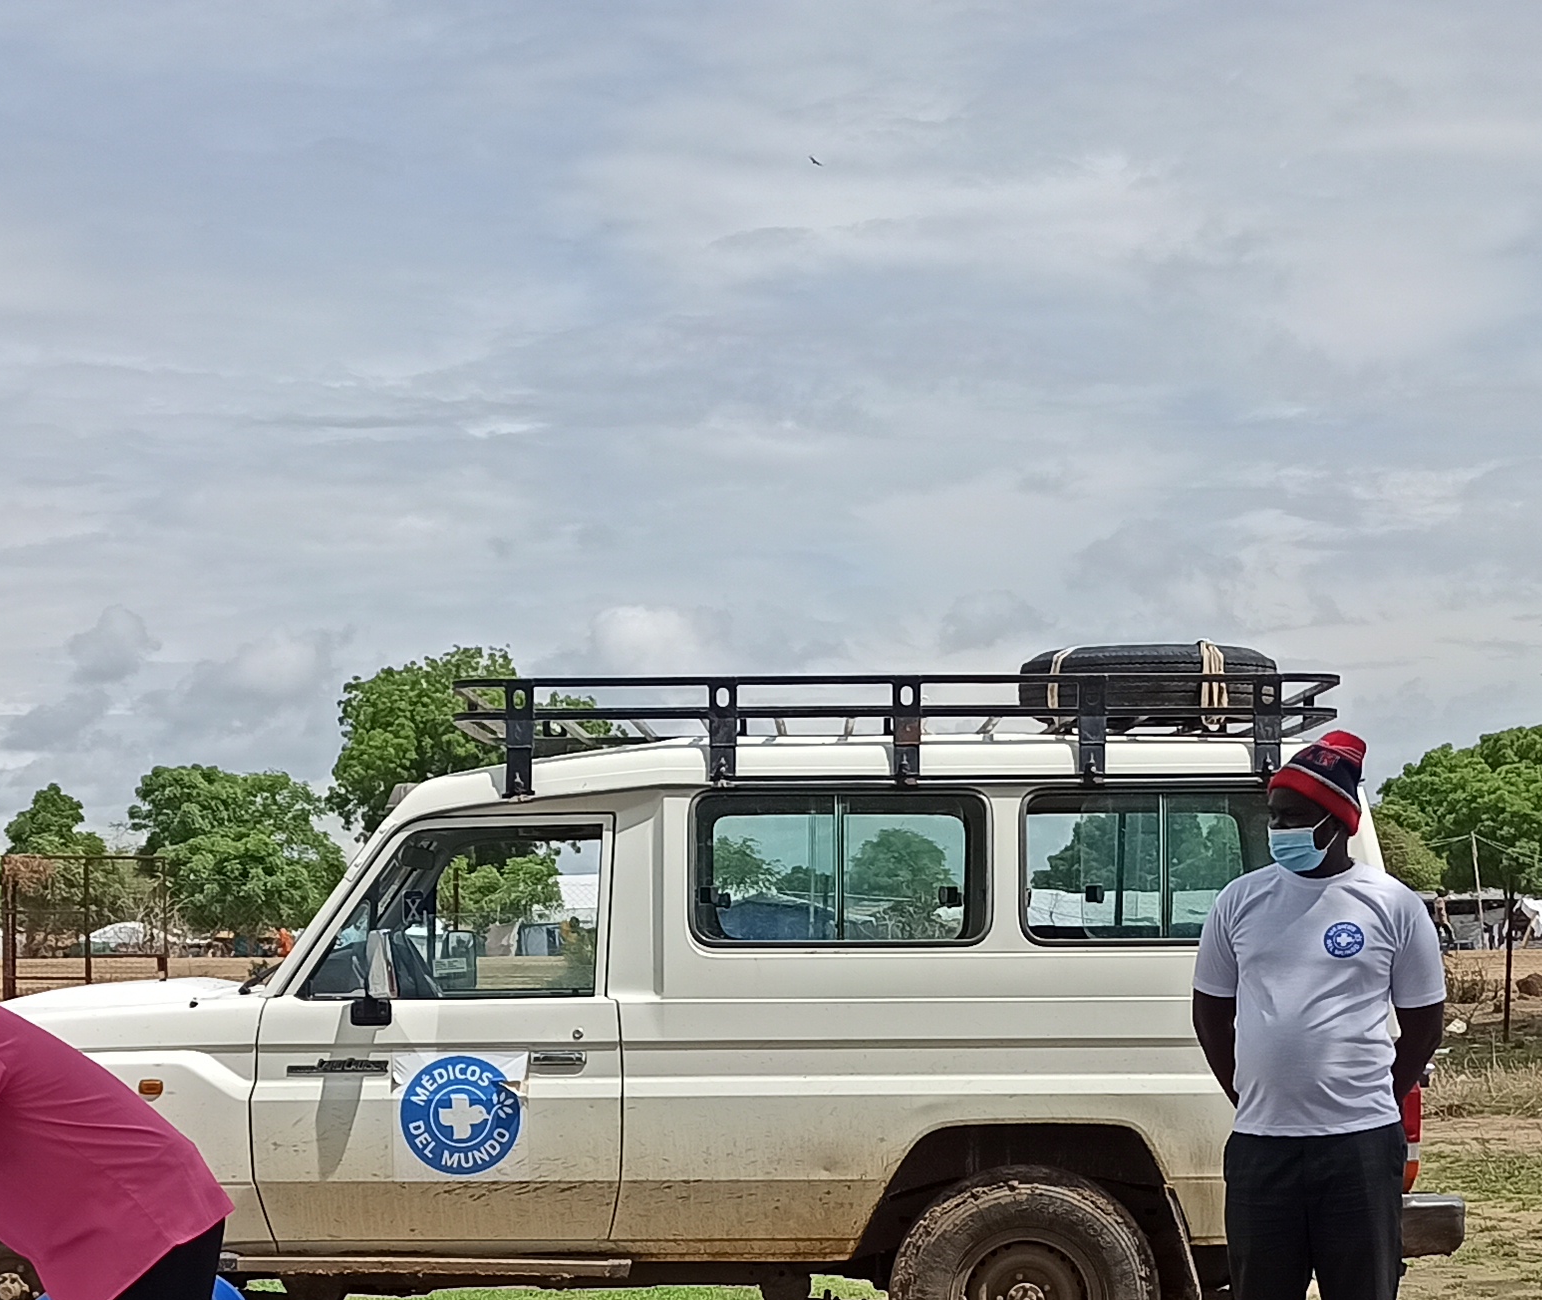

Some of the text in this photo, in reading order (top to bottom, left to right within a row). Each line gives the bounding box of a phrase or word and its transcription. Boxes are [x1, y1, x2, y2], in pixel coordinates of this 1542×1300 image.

[410, 1063, 494, 1106] MÉDICOS
[408, 1120, 510, 1169] DEL MUNDO
